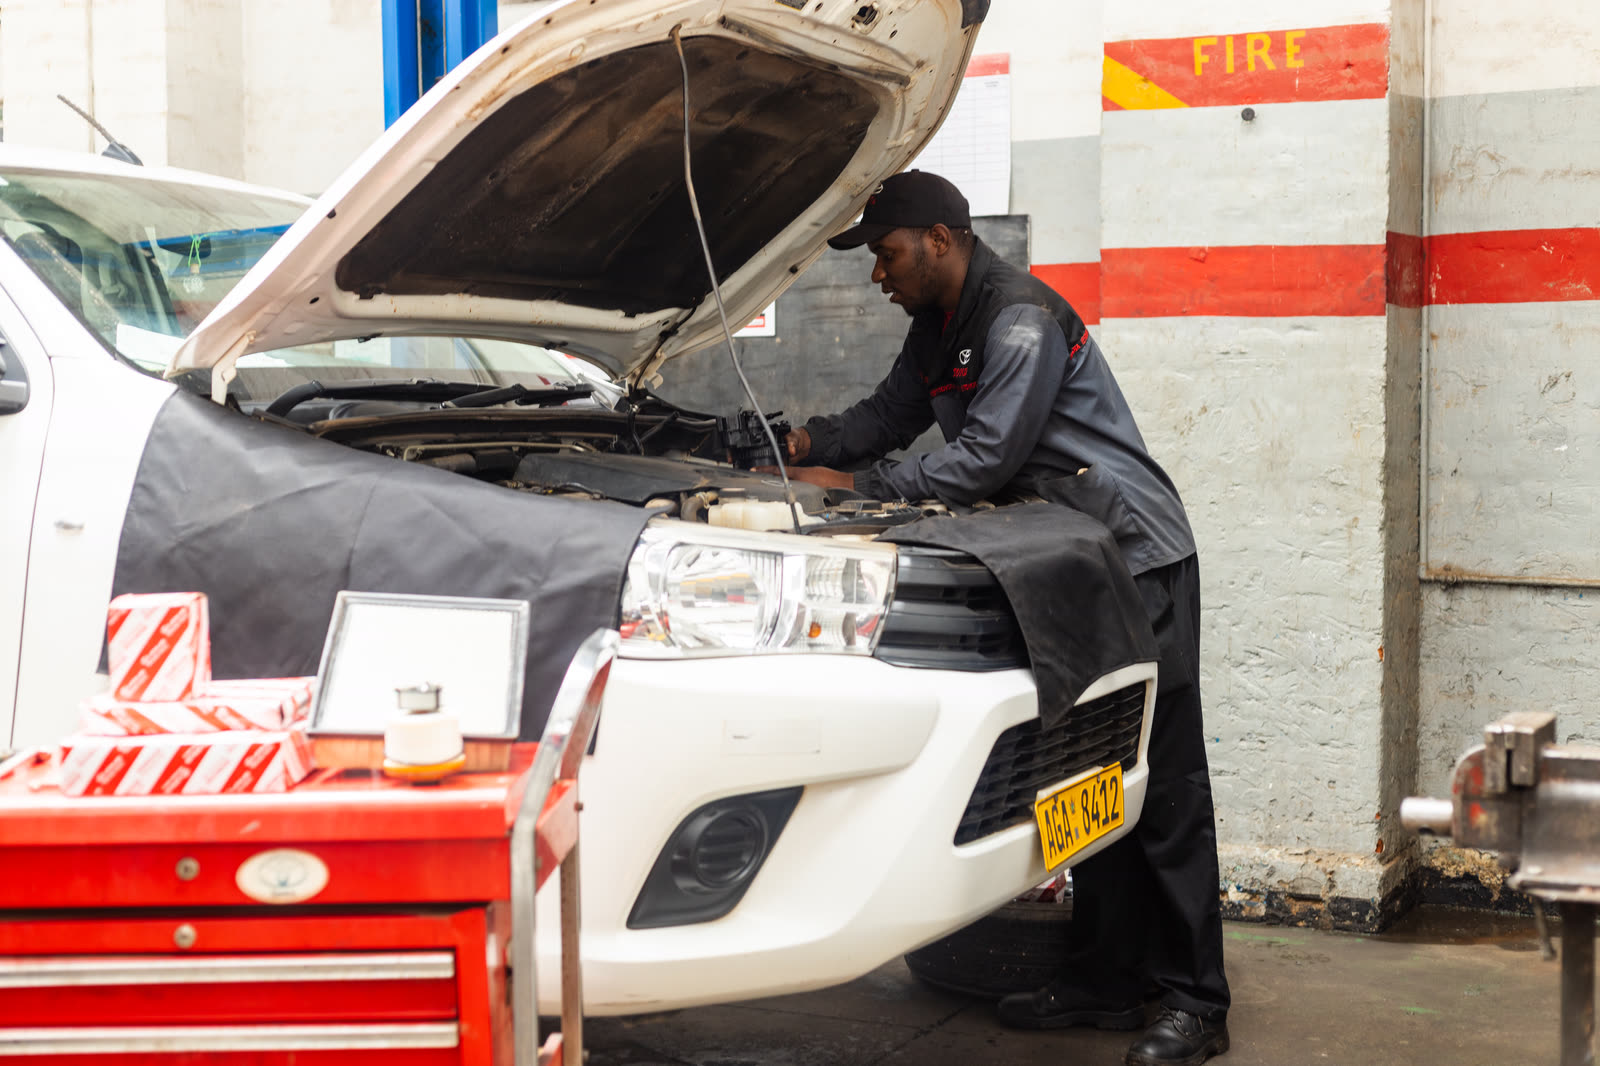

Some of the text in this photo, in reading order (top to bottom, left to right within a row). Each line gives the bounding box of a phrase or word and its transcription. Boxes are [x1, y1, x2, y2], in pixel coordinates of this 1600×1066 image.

[1193, 30, 1306, 76] FIRE
[1044, 775, 1120, 859] AGA 8412
